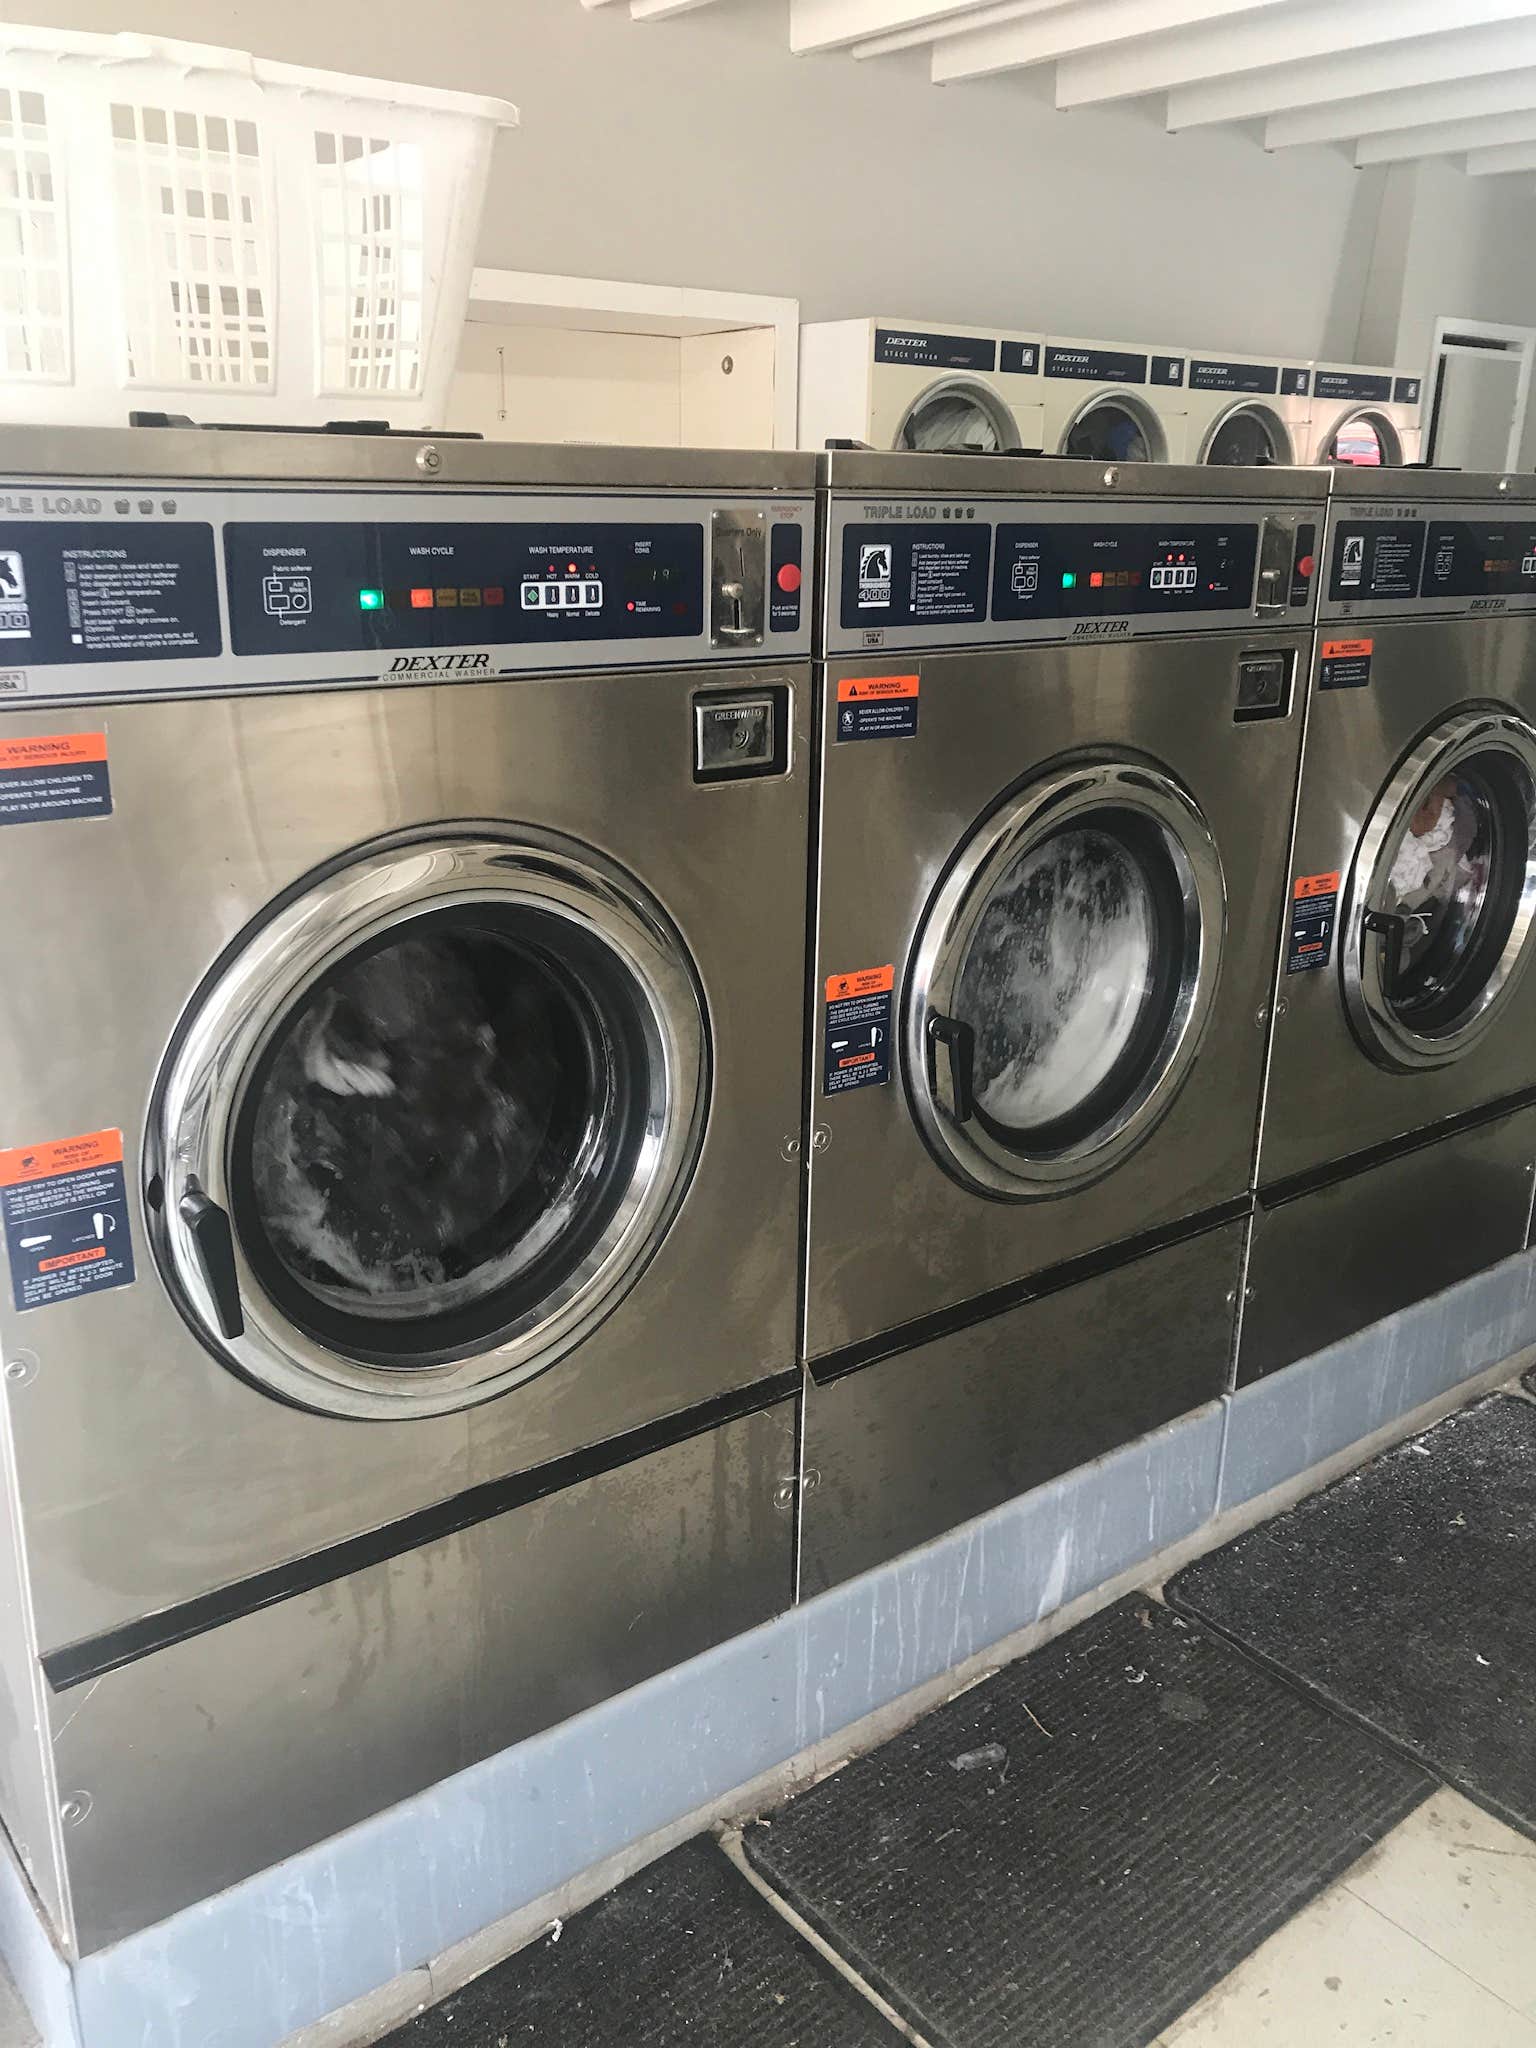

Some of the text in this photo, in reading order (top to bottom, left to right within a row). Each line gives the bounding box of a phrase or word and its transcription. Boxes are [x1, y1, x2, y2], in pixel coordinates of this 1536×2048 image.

[885, 337, 928, 348] DEXTER
[884, 350, 938, 361] STACK DRYER
[1053, 353, 1090, 364] DEXTER
[1197, 367, 1229, 376] DEXTER
[42, 497, 102, 514] LOAD
[863, 505, 937, 519] TRIPLE LOAD
[62, 550, 127, 559] INSTRUCTIONS
[262, 548, 307, 557] DISPENSER
[409, 546, 455, 556] WASH CYCLE
[528, 545, 594, 555] WASH TEMPERATURE
[585, 572, 599, 580] COLD
[858, 589, 891, 601] 400
[1469, 599, 1507, 610] DEXTER
[1072, 621, 1129, 635] DEXTER
[388, 653, 490, 672] DEXTER
[382, 668, 496, 682] COMMERCIAL WASHER
[868, 682, 901, 690] WARNING
[6, 742, 71, 754] WARNING
[53, 1140, 99, 1155] WARNING
[57, 1177, 76, 1185] OPEN
[76, 1172, 96, 1181] DOOR
[53, 1186, 72, 1194] STILL
[72, 1179, 101, 1190] TURNING
[40, 1194, 65, 1205] WATER
[72, 1188, 86, 1196] THE
[87, 1182, 115, 1193] WINDOW
[49, 1199, 70, 1208] LIGHT
[77, 1192, 96, 1202] STILL
[45, 1249, 101, 1269] IMPORTANT
[23, 1281, 47, 1291] THERE
[99, 1262, 124, 1274] MINUTE
[24, 1287, 47, 1298] DELAY
[48, 1281, 76, 1291] BEFORE
[94, 1271, 114, 1281] DOOR
